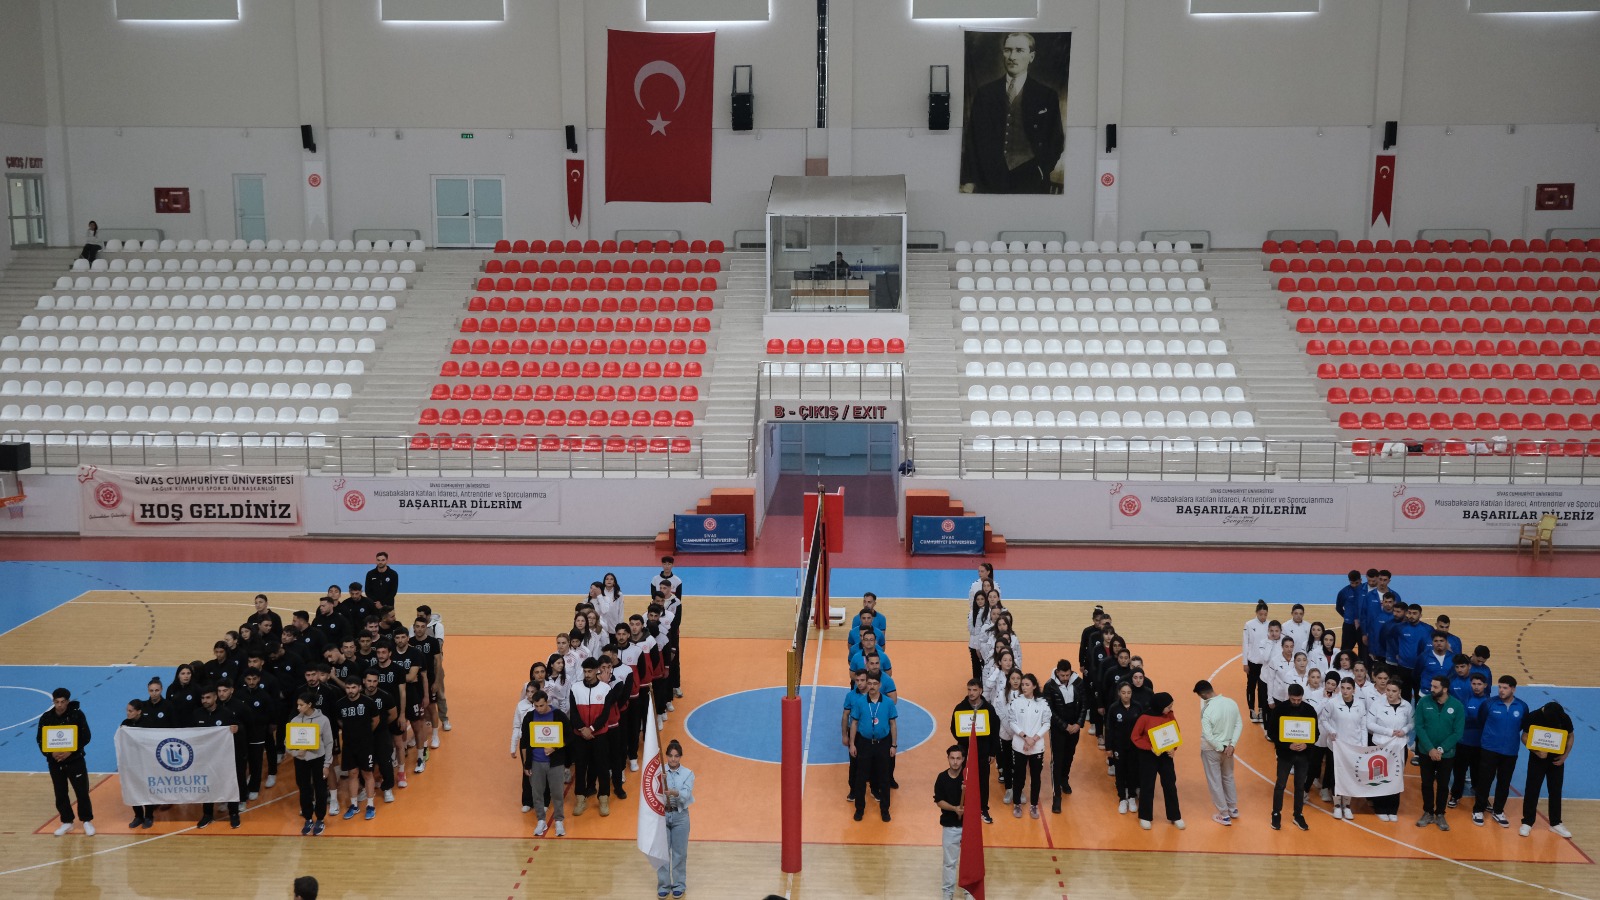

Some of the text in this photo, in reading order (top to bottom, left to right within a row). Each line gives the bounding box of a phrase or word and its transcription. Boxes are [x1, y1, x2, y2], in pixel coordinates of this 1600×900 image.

[774, 406, 785, 418] B
[799, 406, 839, 420] ÇIKIŞ
[842, 405, 849, 420] /
[853, 406, 887, 419] EXIT
[134, 474, 294, 485] SİVAS CUMHURİYET ÜNİVERSİTESİ
[399, 498, 522, 510] BAŞARILAR DİLERİM
[1176, 504, 1307, 516] BAŞARILAR DİLERİM
[140, 500, 291, 521] HOŞ GELDİNİZ
[1463, 510, 1538, 521] BAŞARILAR
[368, 754, 373, 764] 2
[148, 774, 208, 787] BAYBURT
[149, 785, 210, 795] ÜNİVERSİTESİ
